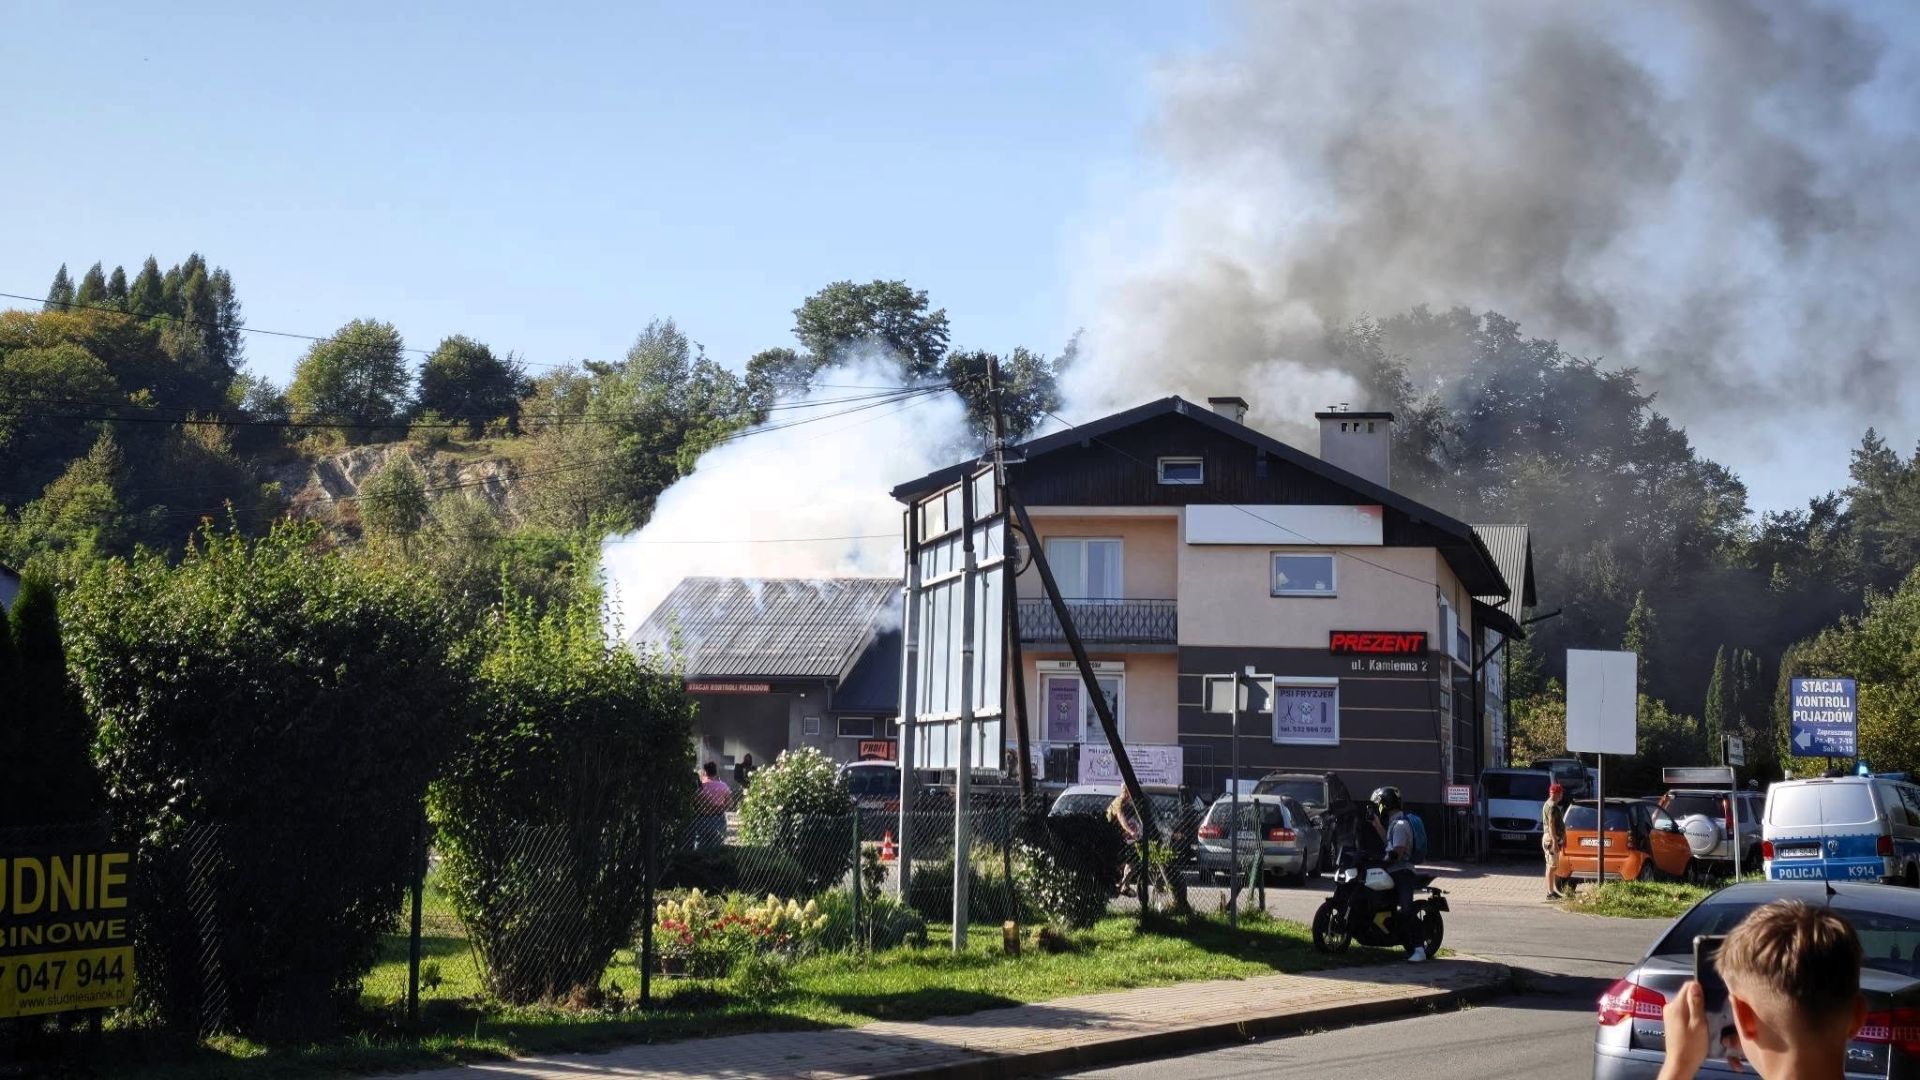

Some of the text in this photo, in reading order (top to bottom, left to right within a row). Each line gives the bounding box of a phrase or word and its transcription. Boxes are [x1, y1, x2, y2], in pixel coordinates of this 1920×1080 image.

[1331, 634, 1424, 652] PREZENT
[1351, 660, 1428, 672] ul. Kamienna 2
[1801, 681, 1843, 693] STACJA
[1295, 690, 1334, 698] FRYZJER
[1795, 695, 1850, 708] KONTROLI
[1792, 708, 1853, 723] POJAZDÓW
[1779, 866, 1875, 879] POLICJA K914
[0, 853, 129, 915] DNIE
[16, 960, 67, 994] 047
[76, 955, 125, 988] 944
